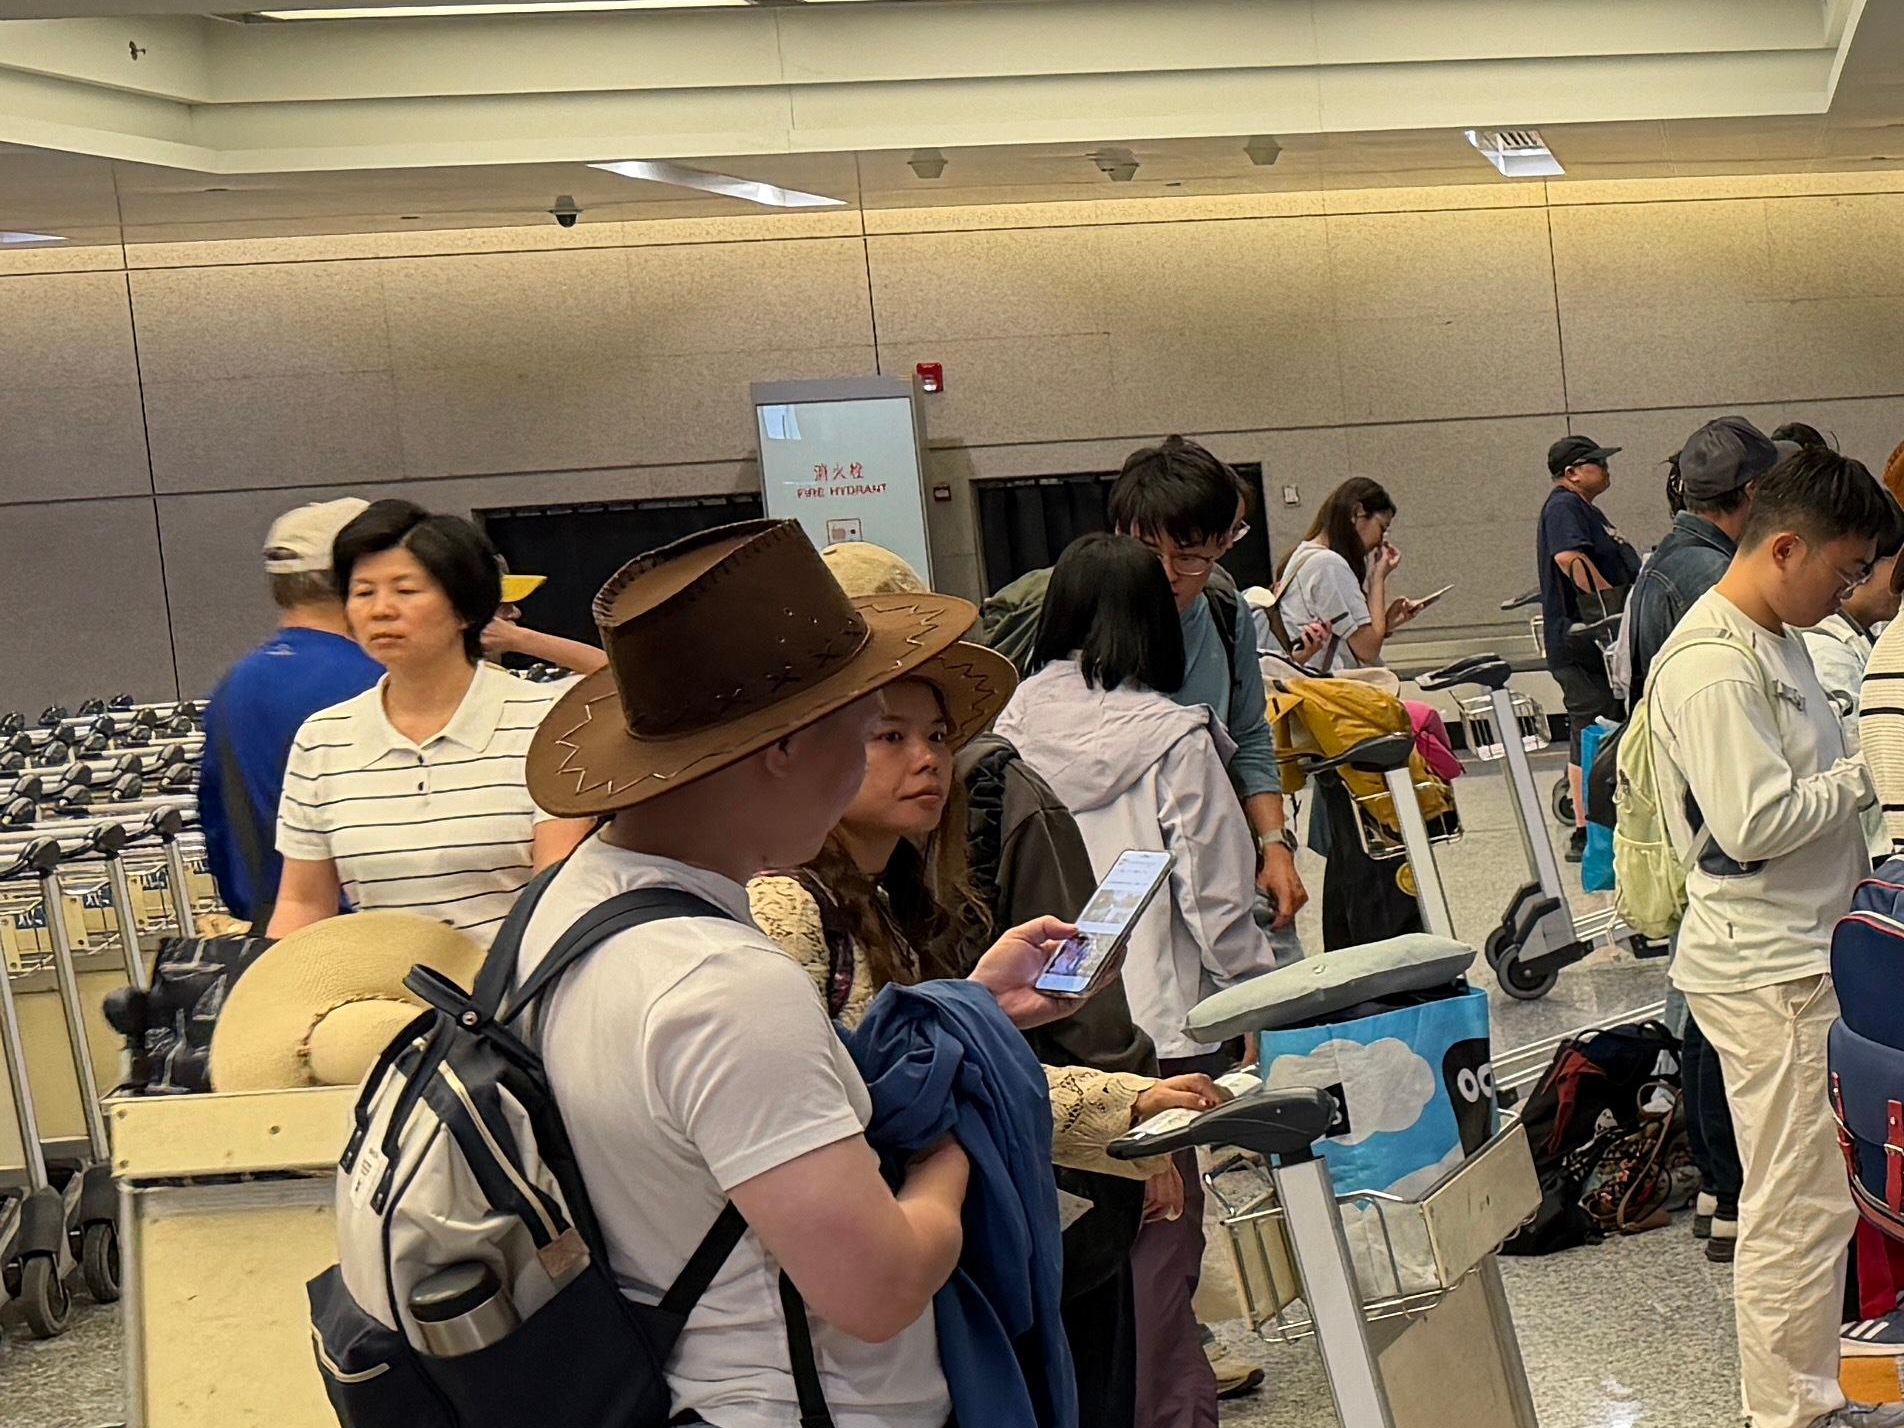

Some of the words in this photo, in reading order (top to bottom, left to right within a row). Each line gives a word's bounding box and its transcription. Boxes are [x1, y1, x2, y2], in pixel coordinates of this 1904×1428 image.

[813, 461, 864, 482] 消火栓
[830, 483, 887, 496] HYDRANT
